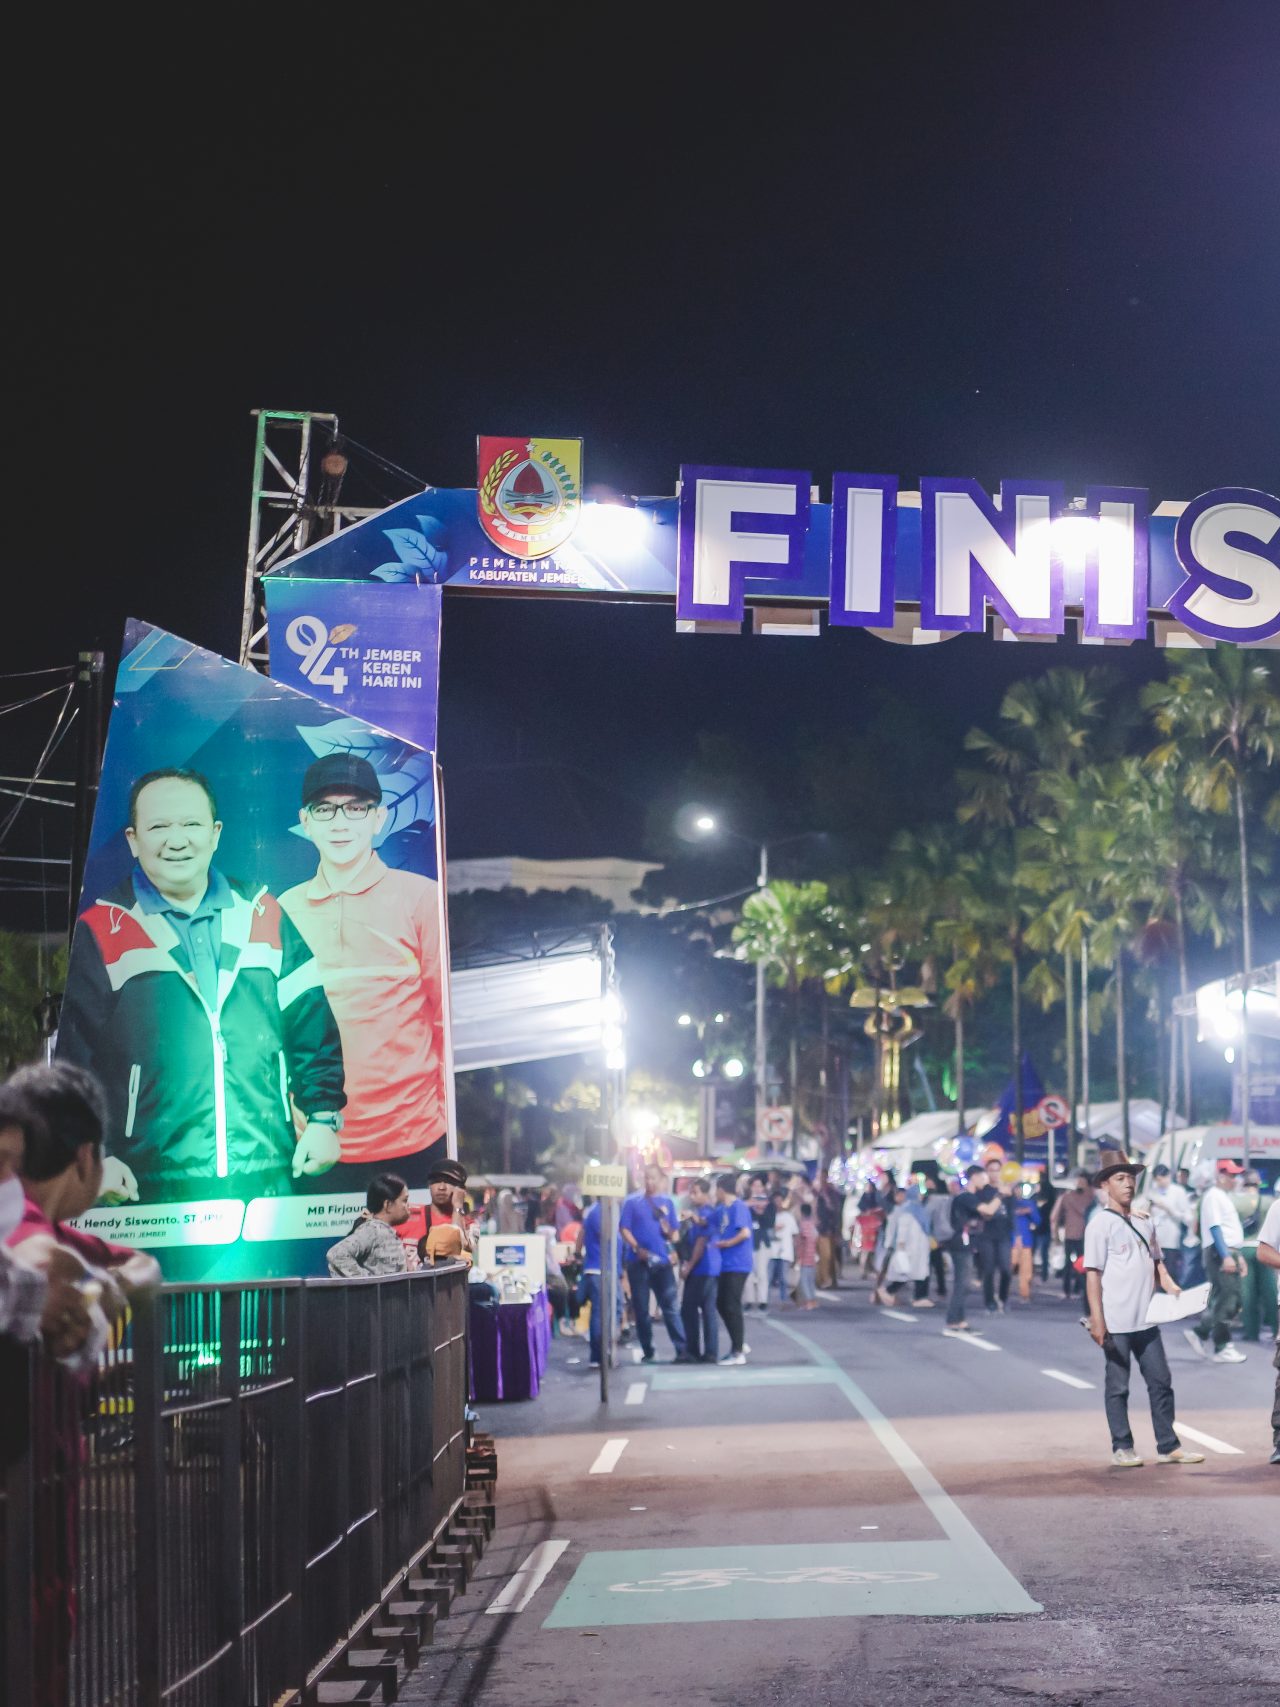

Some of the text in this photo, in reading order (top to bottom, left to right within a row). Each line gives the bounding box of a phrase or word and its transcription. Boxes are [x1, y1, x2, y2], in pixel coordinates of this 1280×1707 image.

[469, 569, 538, 583] KABUPATEN
[362, 648, 422, 663] JEMBER
[362, 661, 411, 675] KEREN
[362, 675, 422, 689] HARI INI
[307, 1205, 325, 1216] MB
[84, 1217, 122, 1229] Hendy
[330, 1219, 354, 1227] BUPAT
[109, 1230, 167, 1240] BUPATI JEMBER
